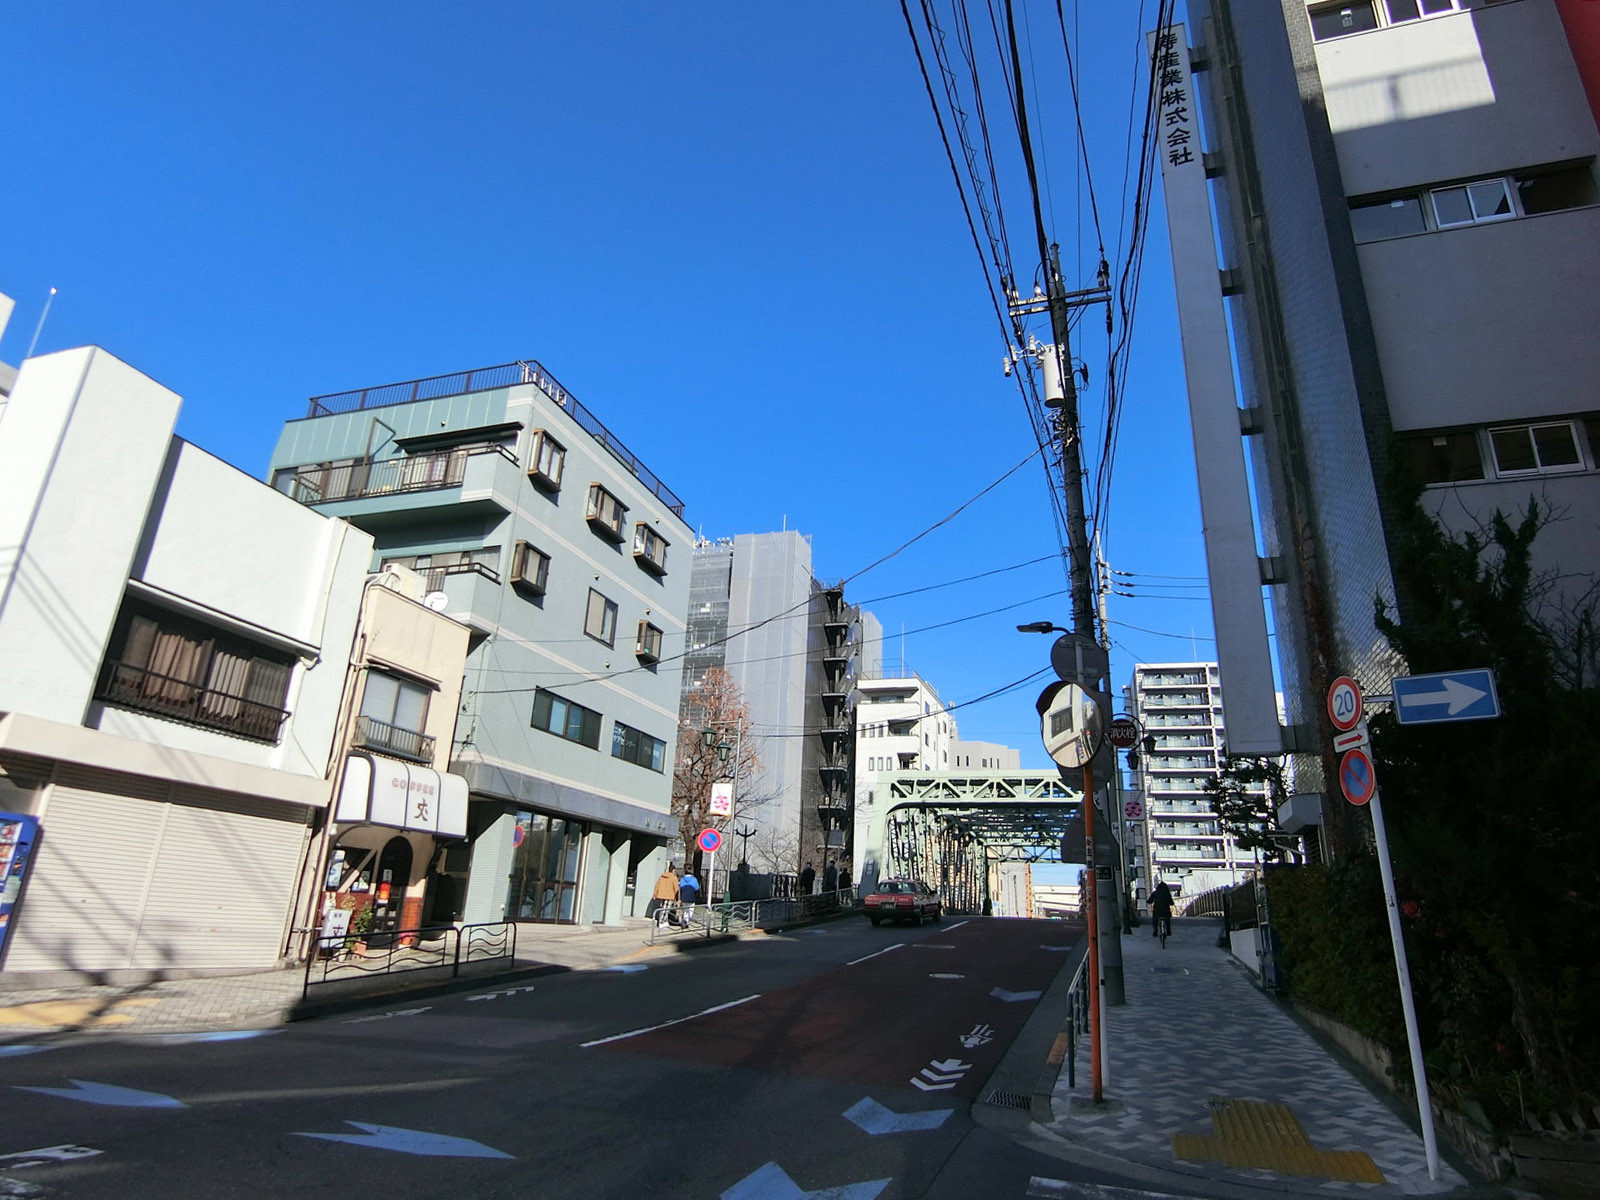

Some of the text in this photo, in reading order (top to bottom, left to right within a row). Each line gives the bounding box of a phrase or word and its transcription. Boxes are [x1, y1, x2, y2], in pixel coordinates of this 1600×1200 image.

[1334, 690, 1354, 717] 20
[1110, 726, 1136, 739] 消火栓
[391, 777, 434, 795] COFFEE
